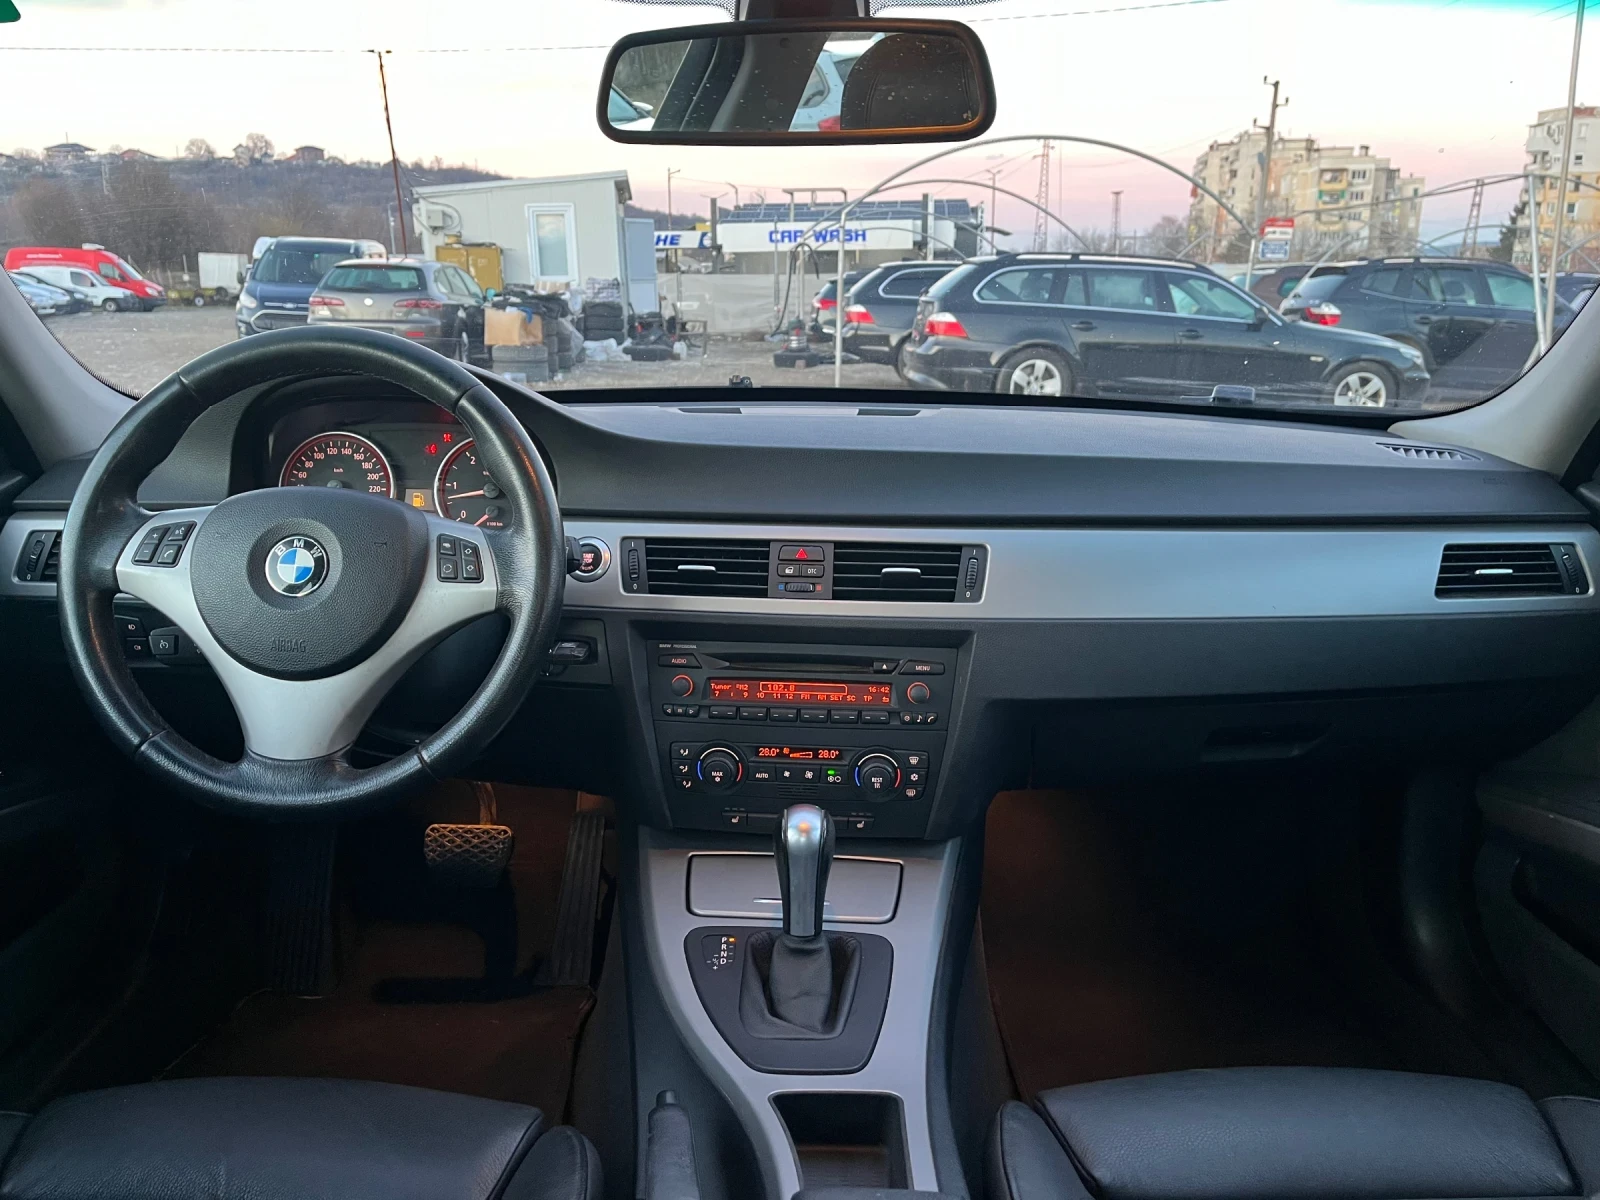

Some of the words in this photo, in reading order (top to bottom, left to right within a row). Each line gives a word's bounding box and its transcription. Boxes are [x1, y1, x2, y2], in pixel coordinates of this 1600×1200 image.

[655, 234, 681, 246] HE
[813, 229, 867, 242] WASH
[327, 447, 338, 455] 120
[313, 452, 325, 460] 100
[353, 453, 364, 461] 160
[470, 456, 476, 465] 2
[368, 485, 381, 493] 220
[460, 510, 467, 519] 0
[275, 539, 322, 558] BMW
[270, 640, 306, 653] AIRBAG
